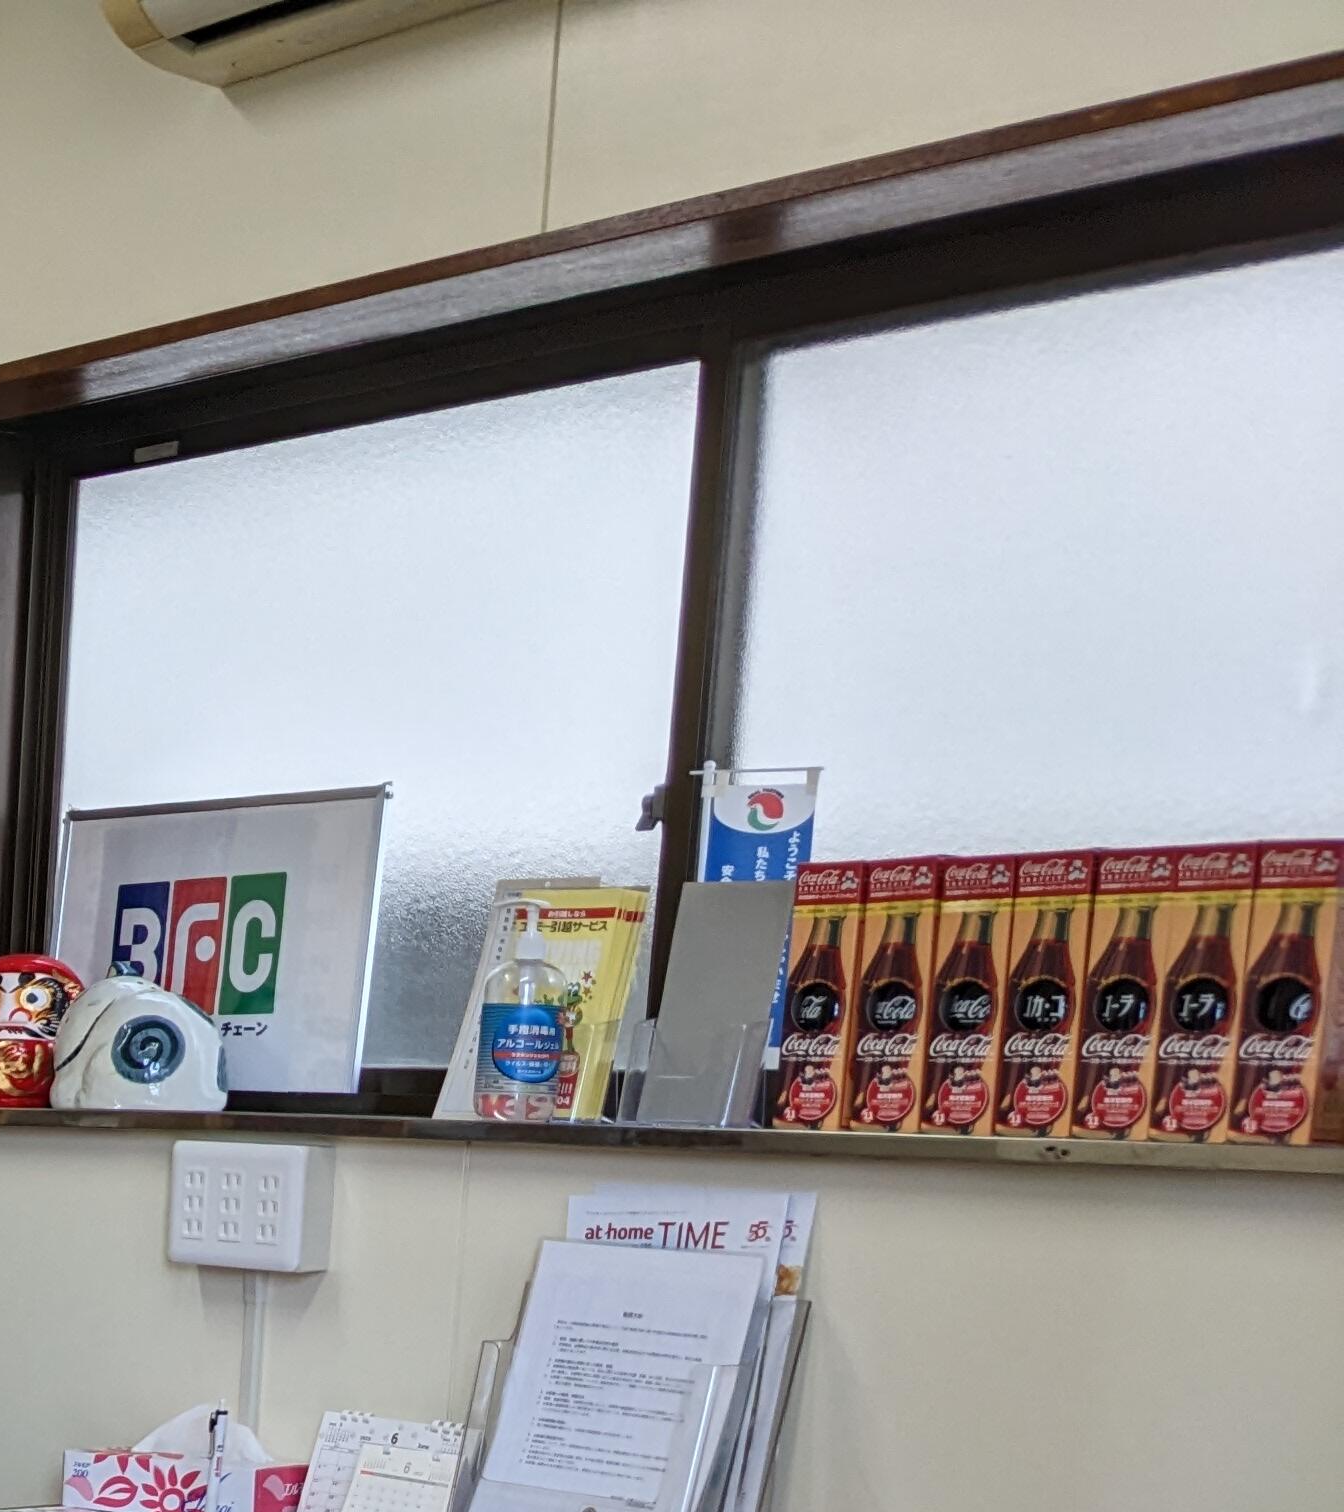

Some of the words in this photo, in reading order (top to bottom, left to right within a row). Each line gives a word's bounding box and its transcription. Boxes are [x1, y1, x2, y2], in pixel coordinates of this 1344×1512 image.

[754, 846, 770, 882] 私たち
[220, 1021, 269, 1038] チェーン
[584, 1225, 603, 1241] at
[605, 1222, 654, 1242] home
[658, 1221, 730, 1250] TIME
[390, 1432, 399, 1445] 6
